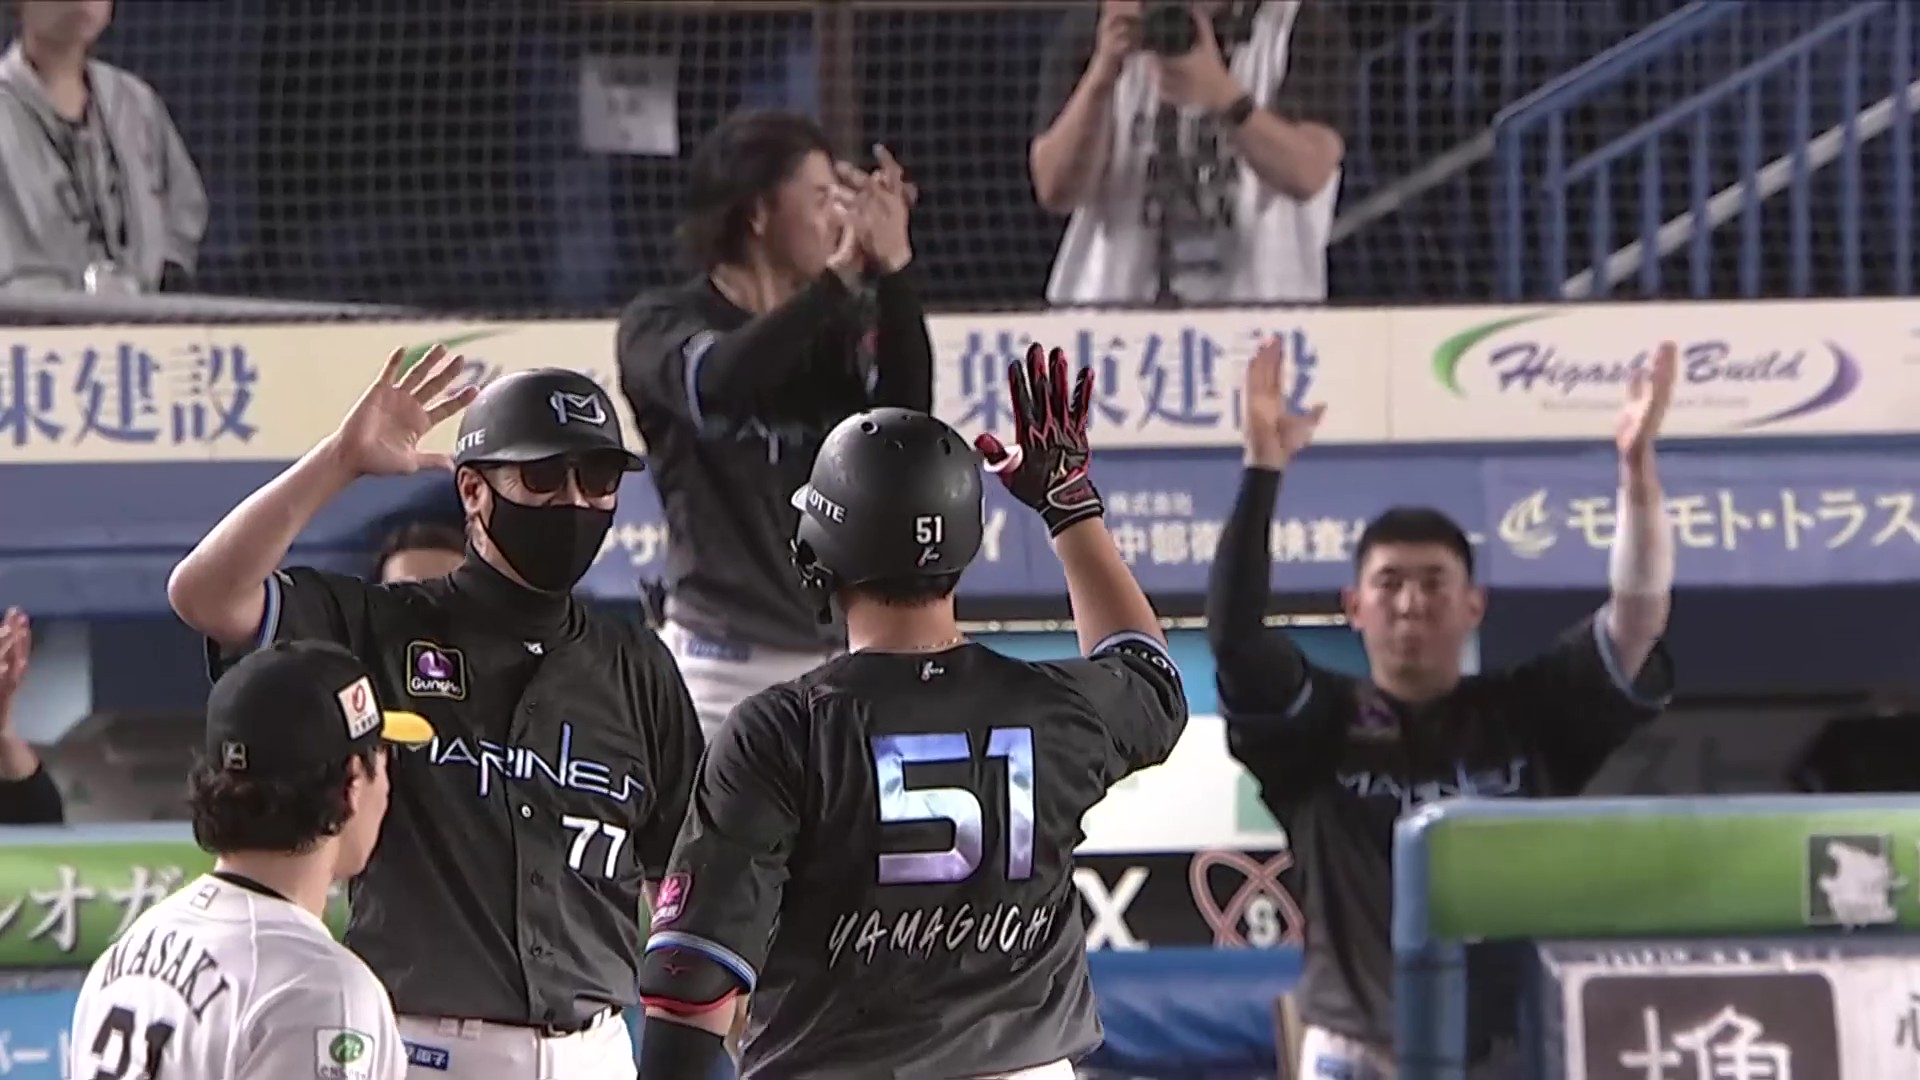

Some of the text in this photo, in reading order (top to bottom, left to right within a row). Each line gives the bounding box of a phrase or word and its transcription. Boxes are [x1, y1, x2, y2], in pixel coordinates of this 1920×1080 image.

[1489, 340, 1806, 395] Higash Build
[916, 515, 943, 544] 51
[1565, 488, 1920, 550] モモト・トラス
[869, 726, 1035, 887] 51
[562, 815, 627, 880] 77
[828, 904, 1057, 970] YAMAGUCHI
[101, 926, 231, 1022] MASAKI
